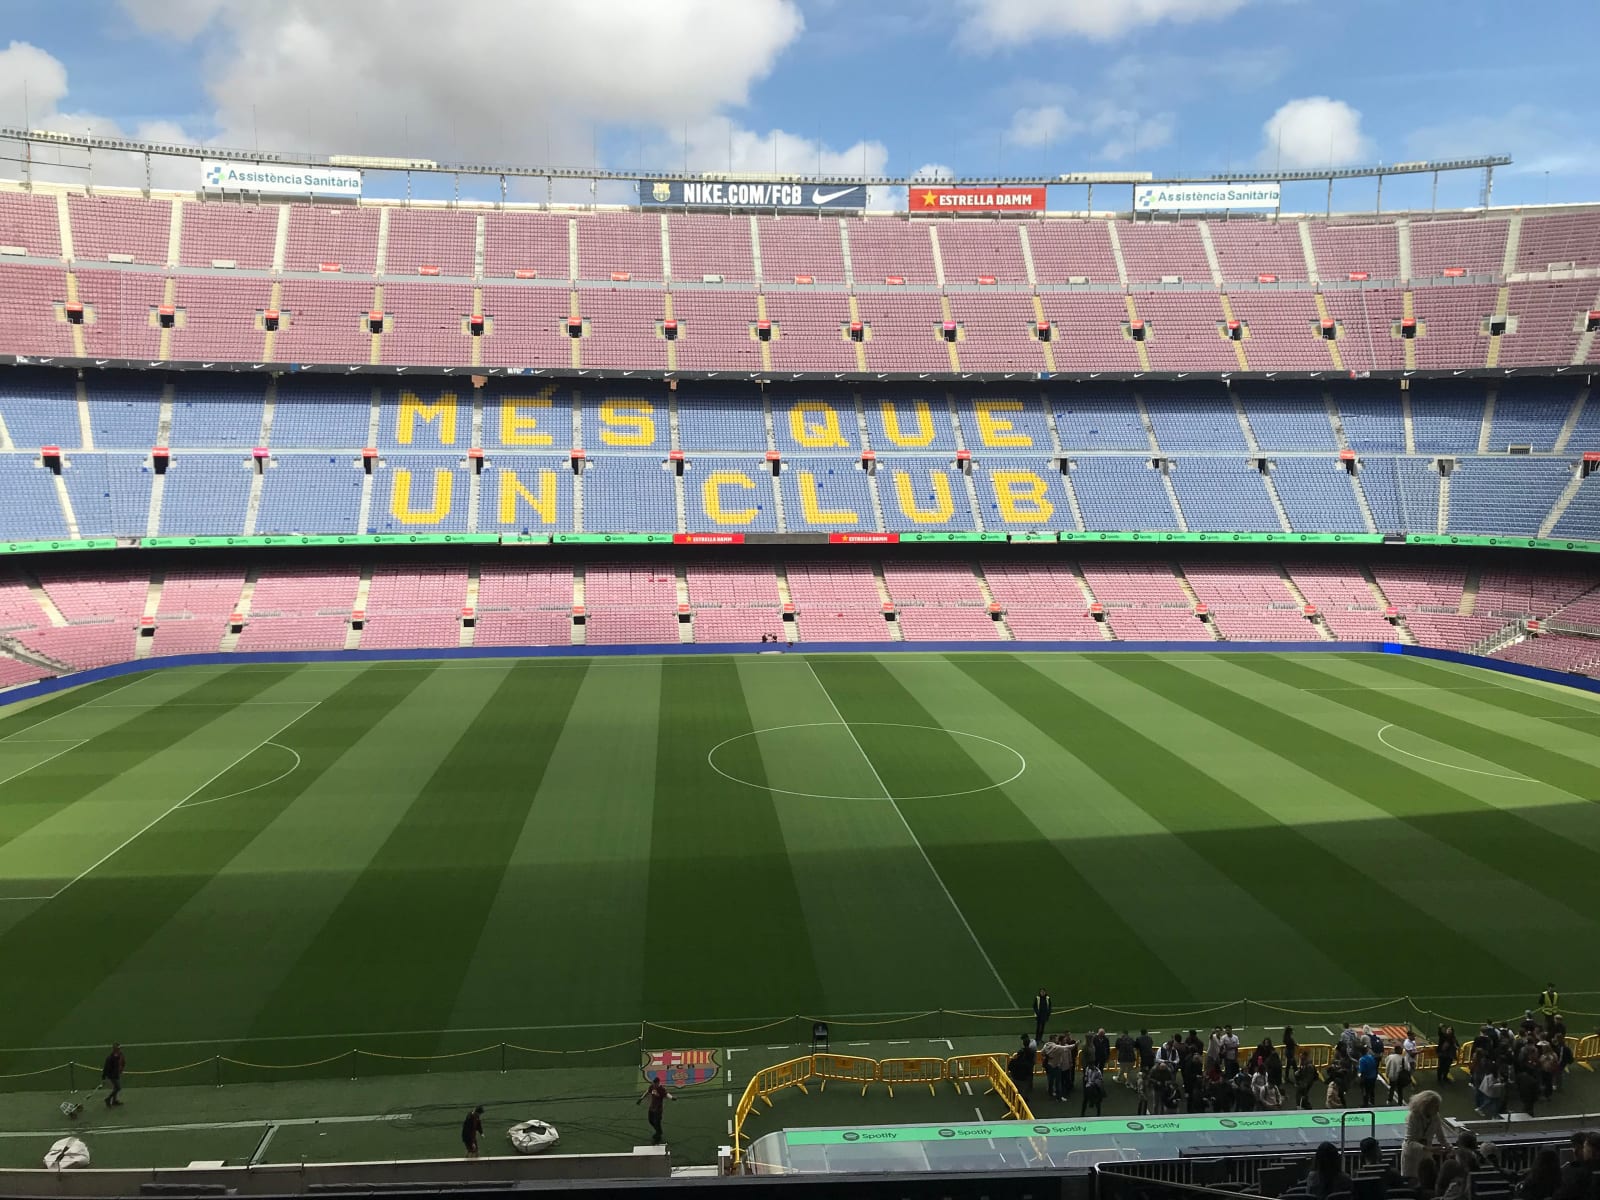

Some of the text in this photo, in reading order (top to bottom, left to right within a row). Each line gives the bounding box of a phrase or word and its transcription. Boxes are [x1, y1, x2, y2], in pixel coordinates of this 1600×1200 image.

[228, 169, 302, 185] Assistència
[684, 183, 802, 205] NIKE.COM/FCB
[939, 194, 1032, 206] ESTRELLA DAMM
[788, 399, 1033, 448] QUE
[390, 467, 1054, 525] UN CLUB
[1052, 1125, 1087, 1133] Spotify
